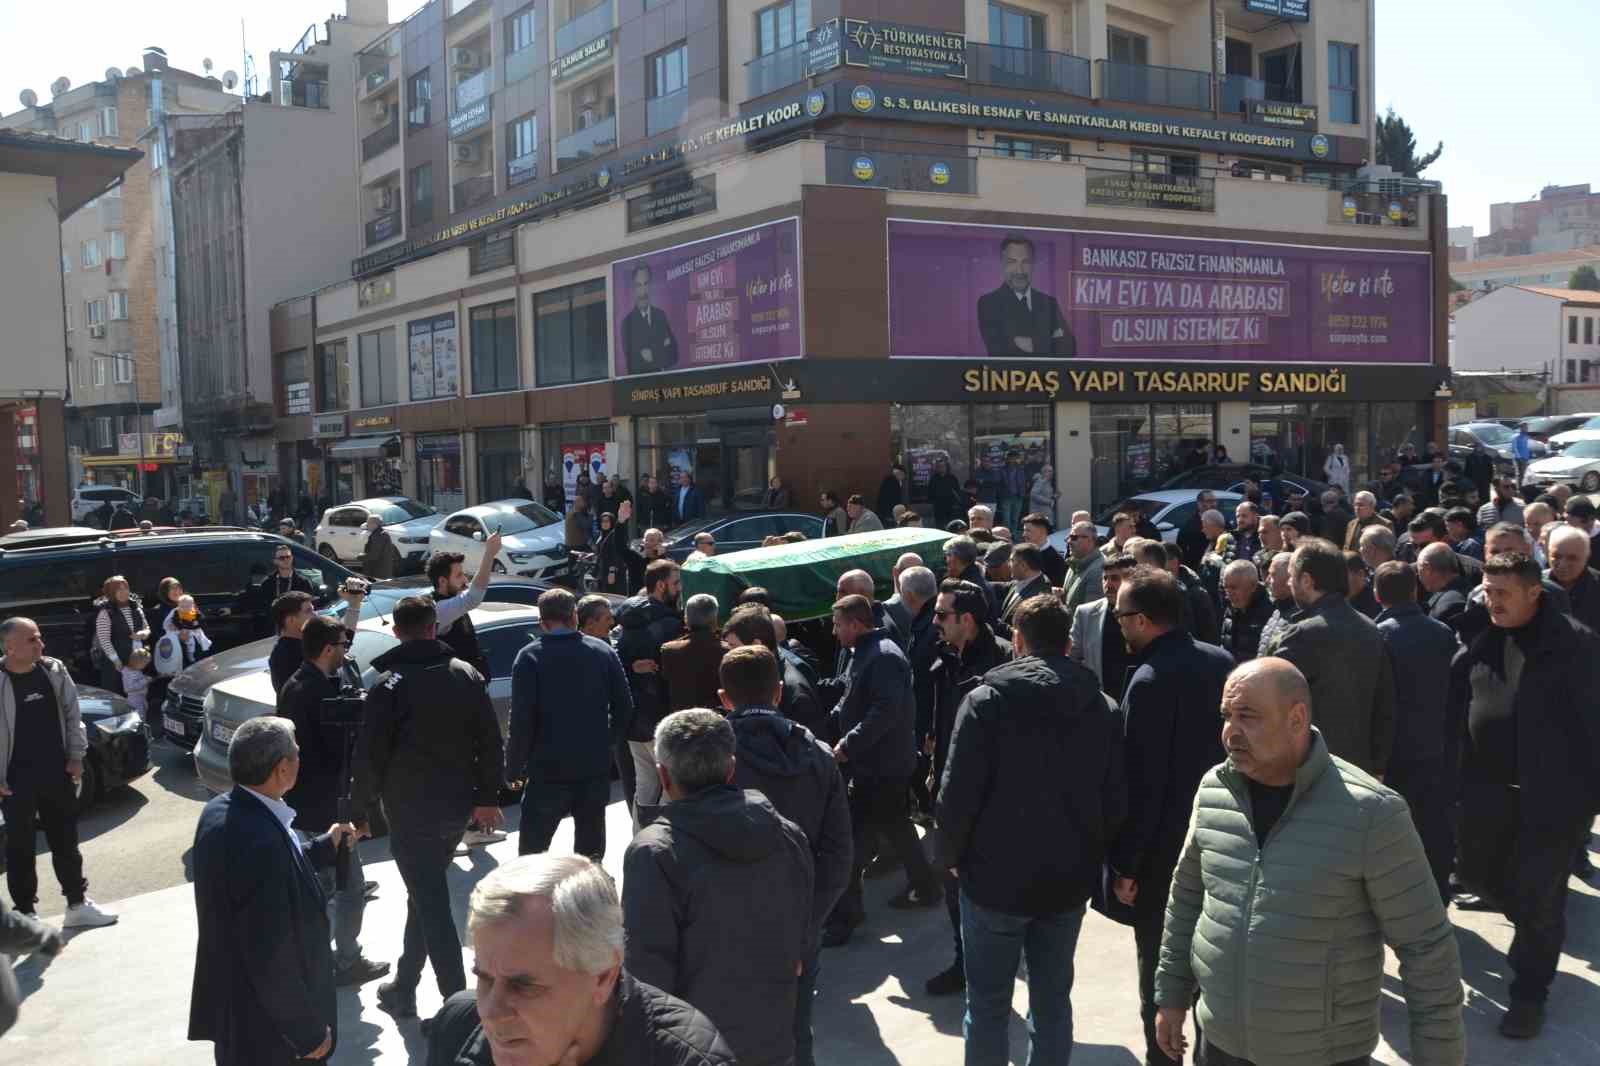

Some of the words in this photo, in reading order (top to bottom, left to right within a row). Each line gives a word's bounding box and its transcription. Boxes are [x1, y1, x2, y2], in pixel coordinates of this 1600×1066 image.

[883, 27, 962, 50] TÜRKMENLER
[884, 45, 947, 62] RESTORASYON
[766, 103, 801, 126] KOOP.
[883, 96, 895, 108] S.
[898, 98, 910, 109] S.
[913, 99, 981, 116] BALIKESİR
[983, 106, 1023, 120] ESNAF
[1026, 110, 1041, 122] VE
[1043, 112, 1127, 130] SANATKARLAR
[1129, 118, 1162, 134] KREDİ
[1165, 122, 1181, 136] VE
[1182, 124, 1228, 142] KEFALET
[1229, 129, 1295, 149] KOOPERATİFİ
[1082, 247, 1147, 269] BANKASIZ
[1151, 252, 1195, 272] FAİZSİZ
[1198, 254, 1285, 276] FİNANSMANLA
[1075, 278, 1112, 305] KİM
[1117, 280, 1147, 307] EVİ
[1154, 282, 1175, 307] YA
[1181, 283, 1203, 308] DA
[1208, 284, 1284, 311] ARABASI
[1320, 268, 1356, 304] Yeter
[1112, 318, 1169, 342] OLSUN
[1172, 316, 1240, 342] İSTEMEZ
[1244, 315, 1260, 340] Kİ
[661, 387, 682, 401] YAPI
[683, 382, 729, 398] TASARRUF
[963, 365, 1060, 398] SİNPAŞ
[1068, 370, 1125, 393] YAPI
[1135, 370, 1251, 393] TASARRUF
[1259, 367, 1348, 394] SANDIĞI
